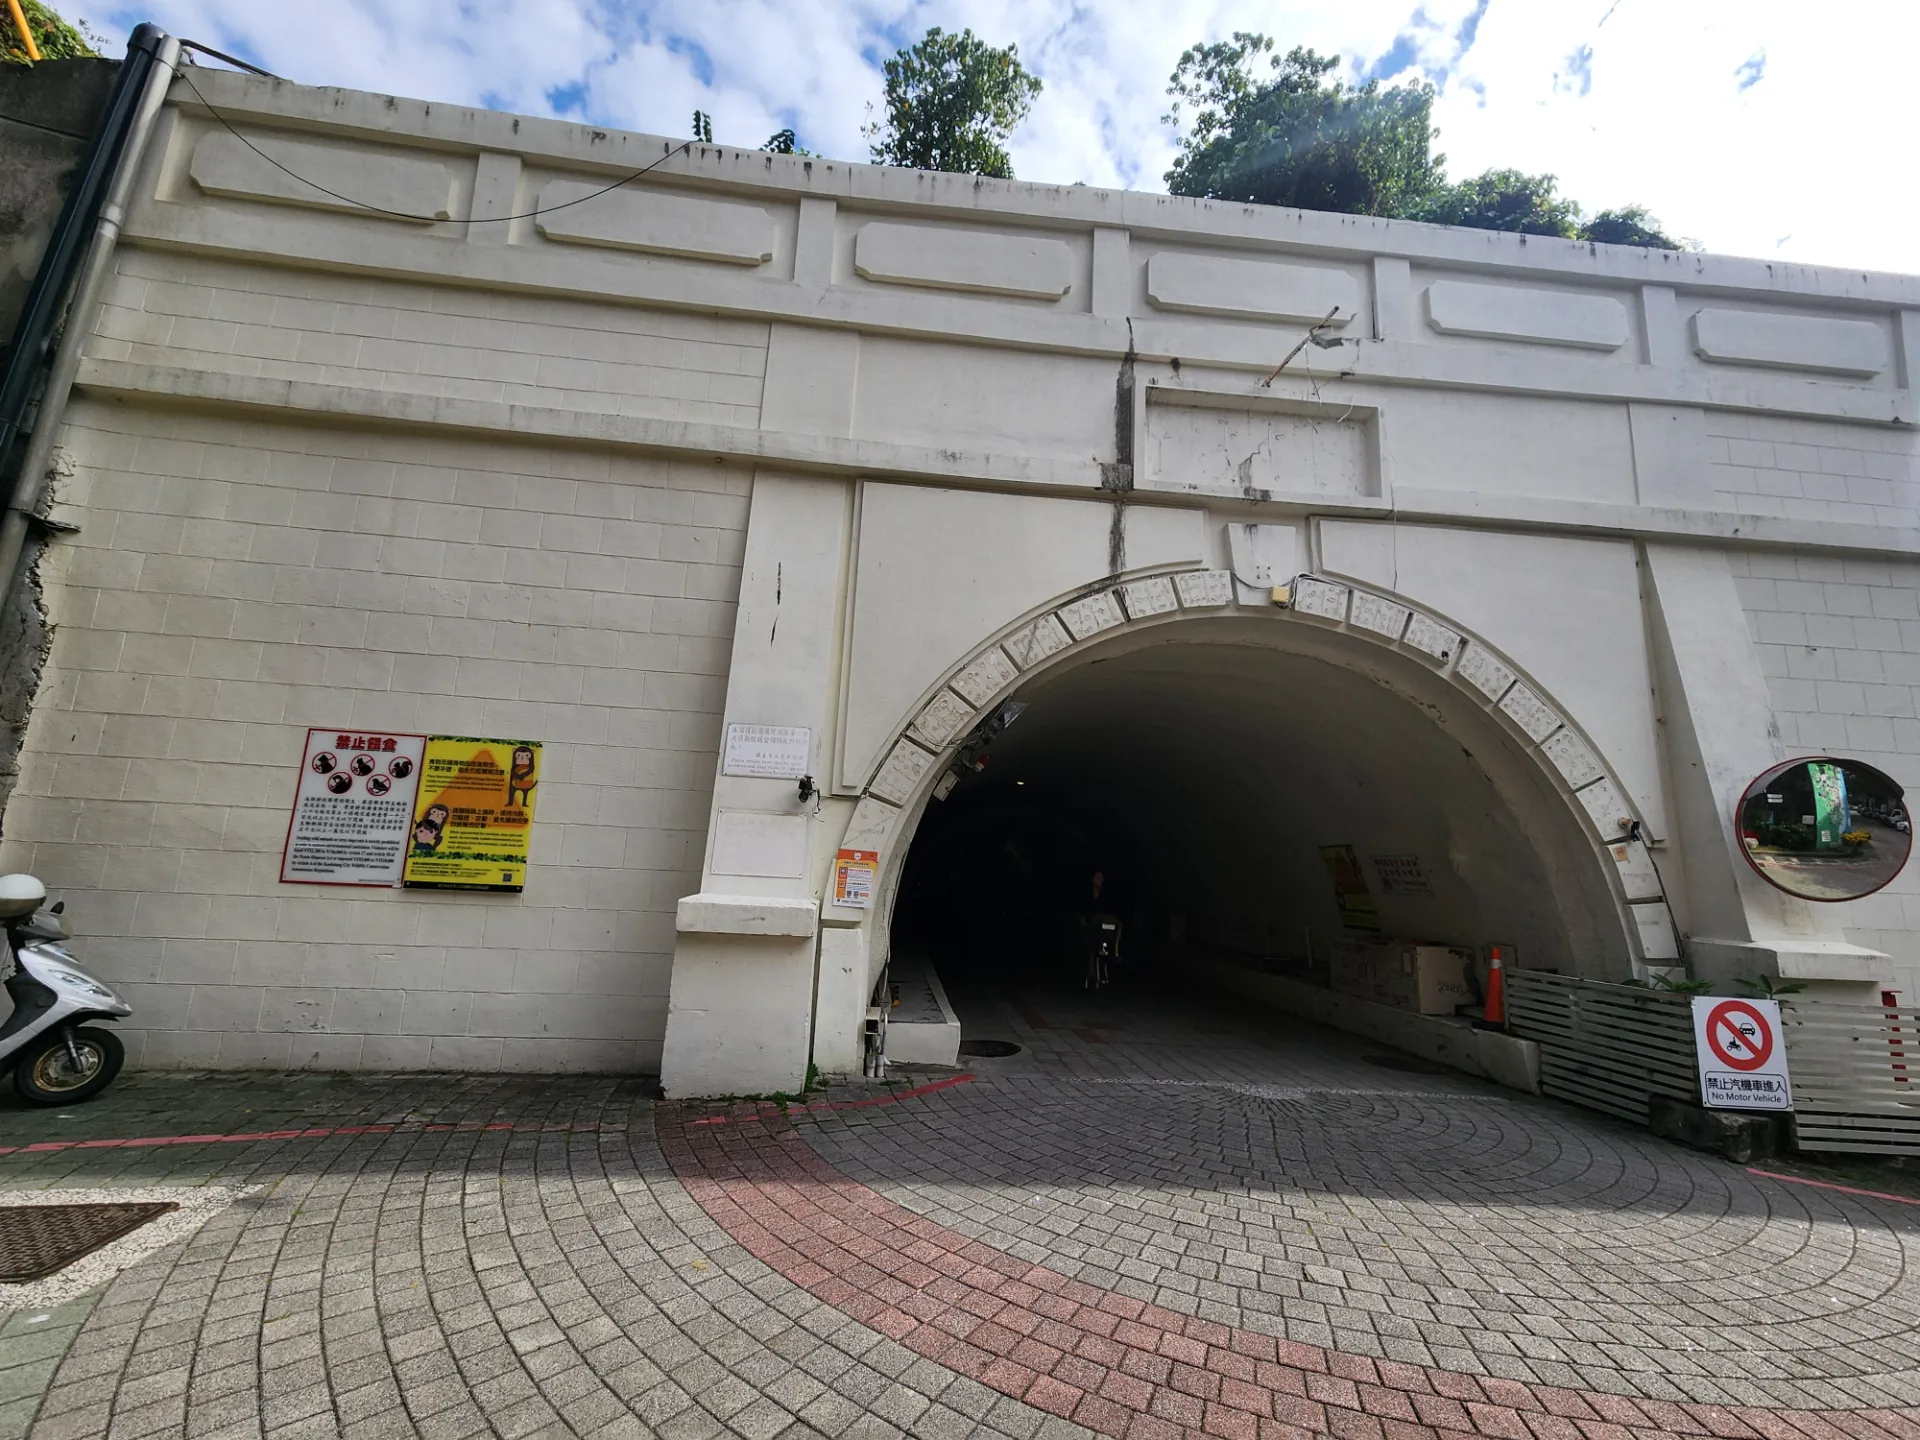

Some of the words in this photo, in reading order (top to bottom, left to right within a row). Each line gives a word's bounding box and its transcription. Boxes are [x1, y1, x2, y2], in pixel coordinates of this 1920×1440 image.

[336, 735, 398, 753] 禁止餵食
[1707, 1077, 1785, 1093] 禁止汽機車進入
[1712, 1092, 1724, 1100] No
[1726, 1093, 1751, 1102] Motor
[1753, 1094, 1782, 1103] Vehicle
